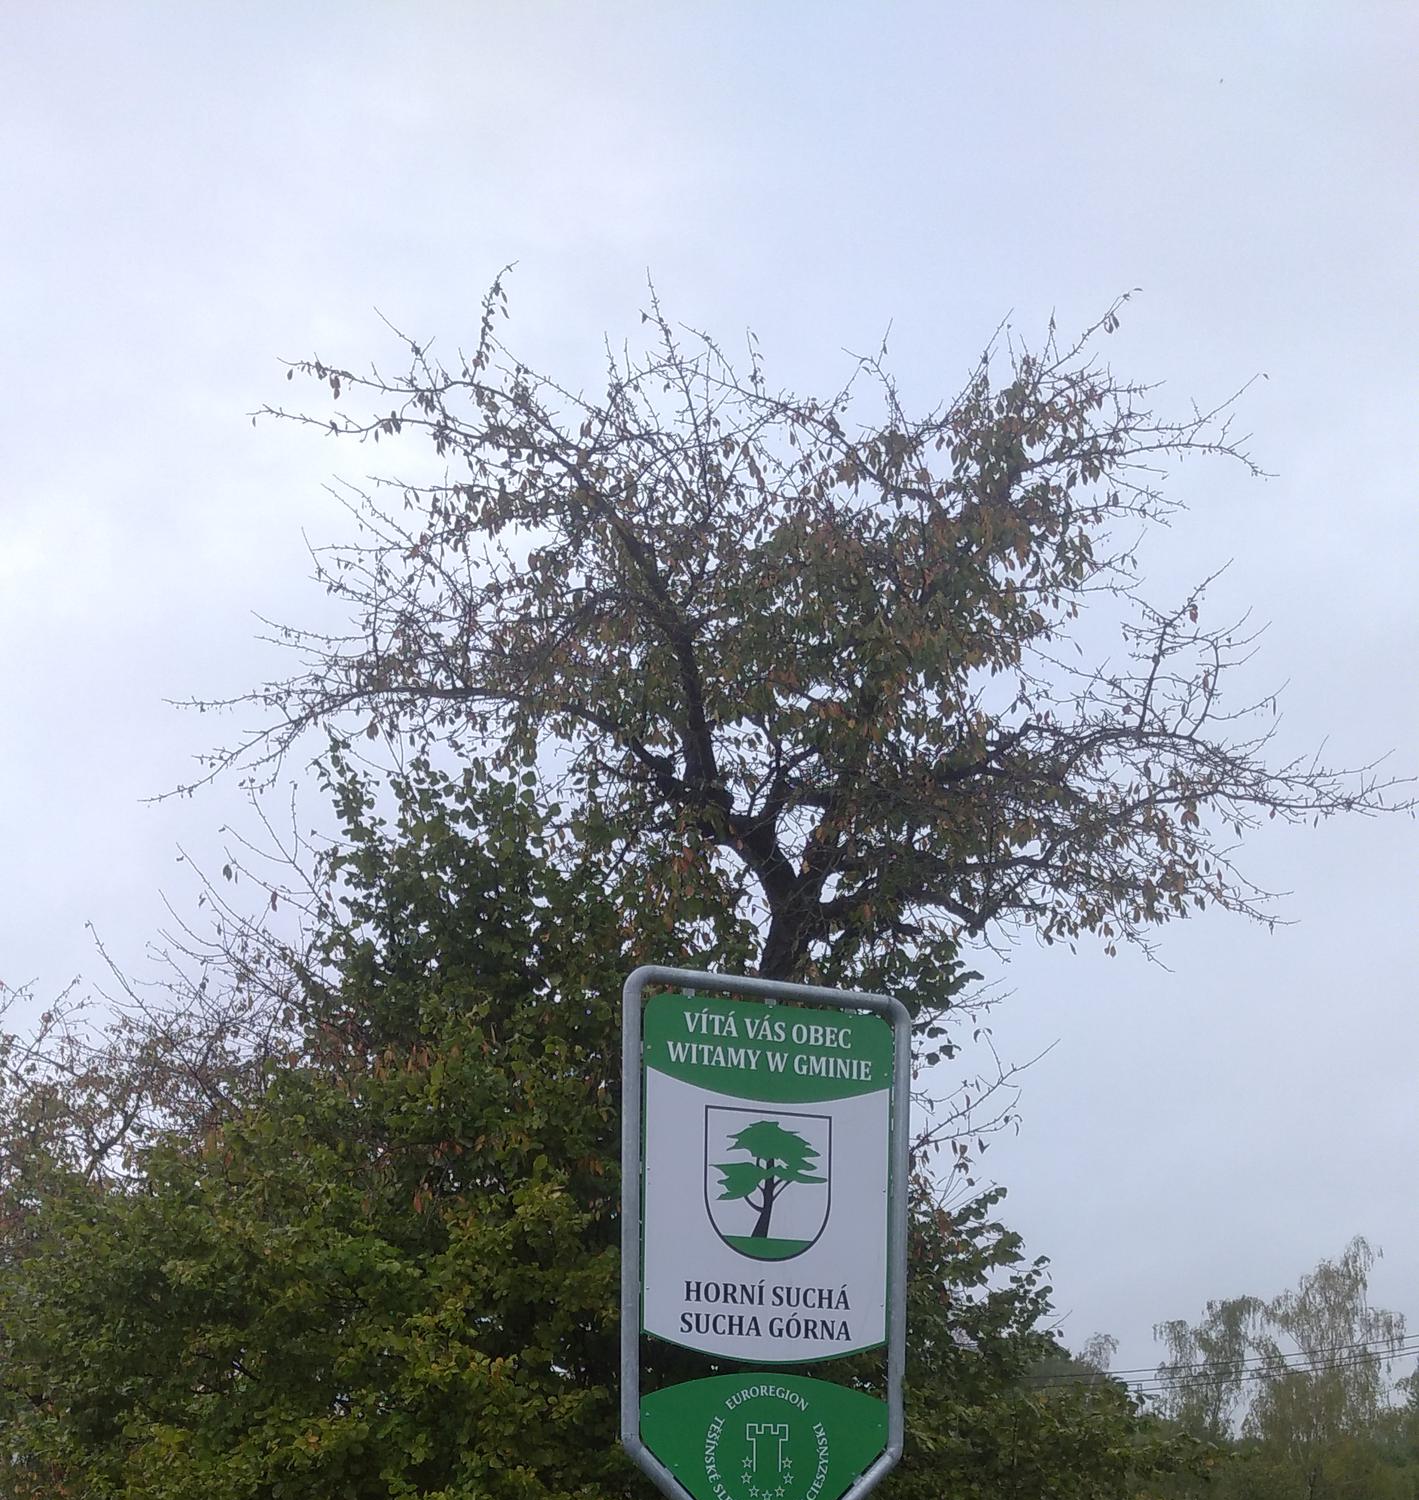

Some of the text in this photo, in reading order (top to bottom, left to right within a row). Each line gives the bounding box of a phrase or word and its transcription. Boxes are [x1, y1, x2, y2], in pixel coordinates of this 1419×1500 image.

[684, 1008, 852, 1049] VÍTÁ VÁS OBEC
[667, 1041, 872, 1081] WITAMY W GMINIE
[684, 1280, 851, 1310] HORNÍ SUCHÁ
[679, 1312, 852, 1341] SUCHA GÓRNA
[725, 1385, 809, 1412] EUROREGION
